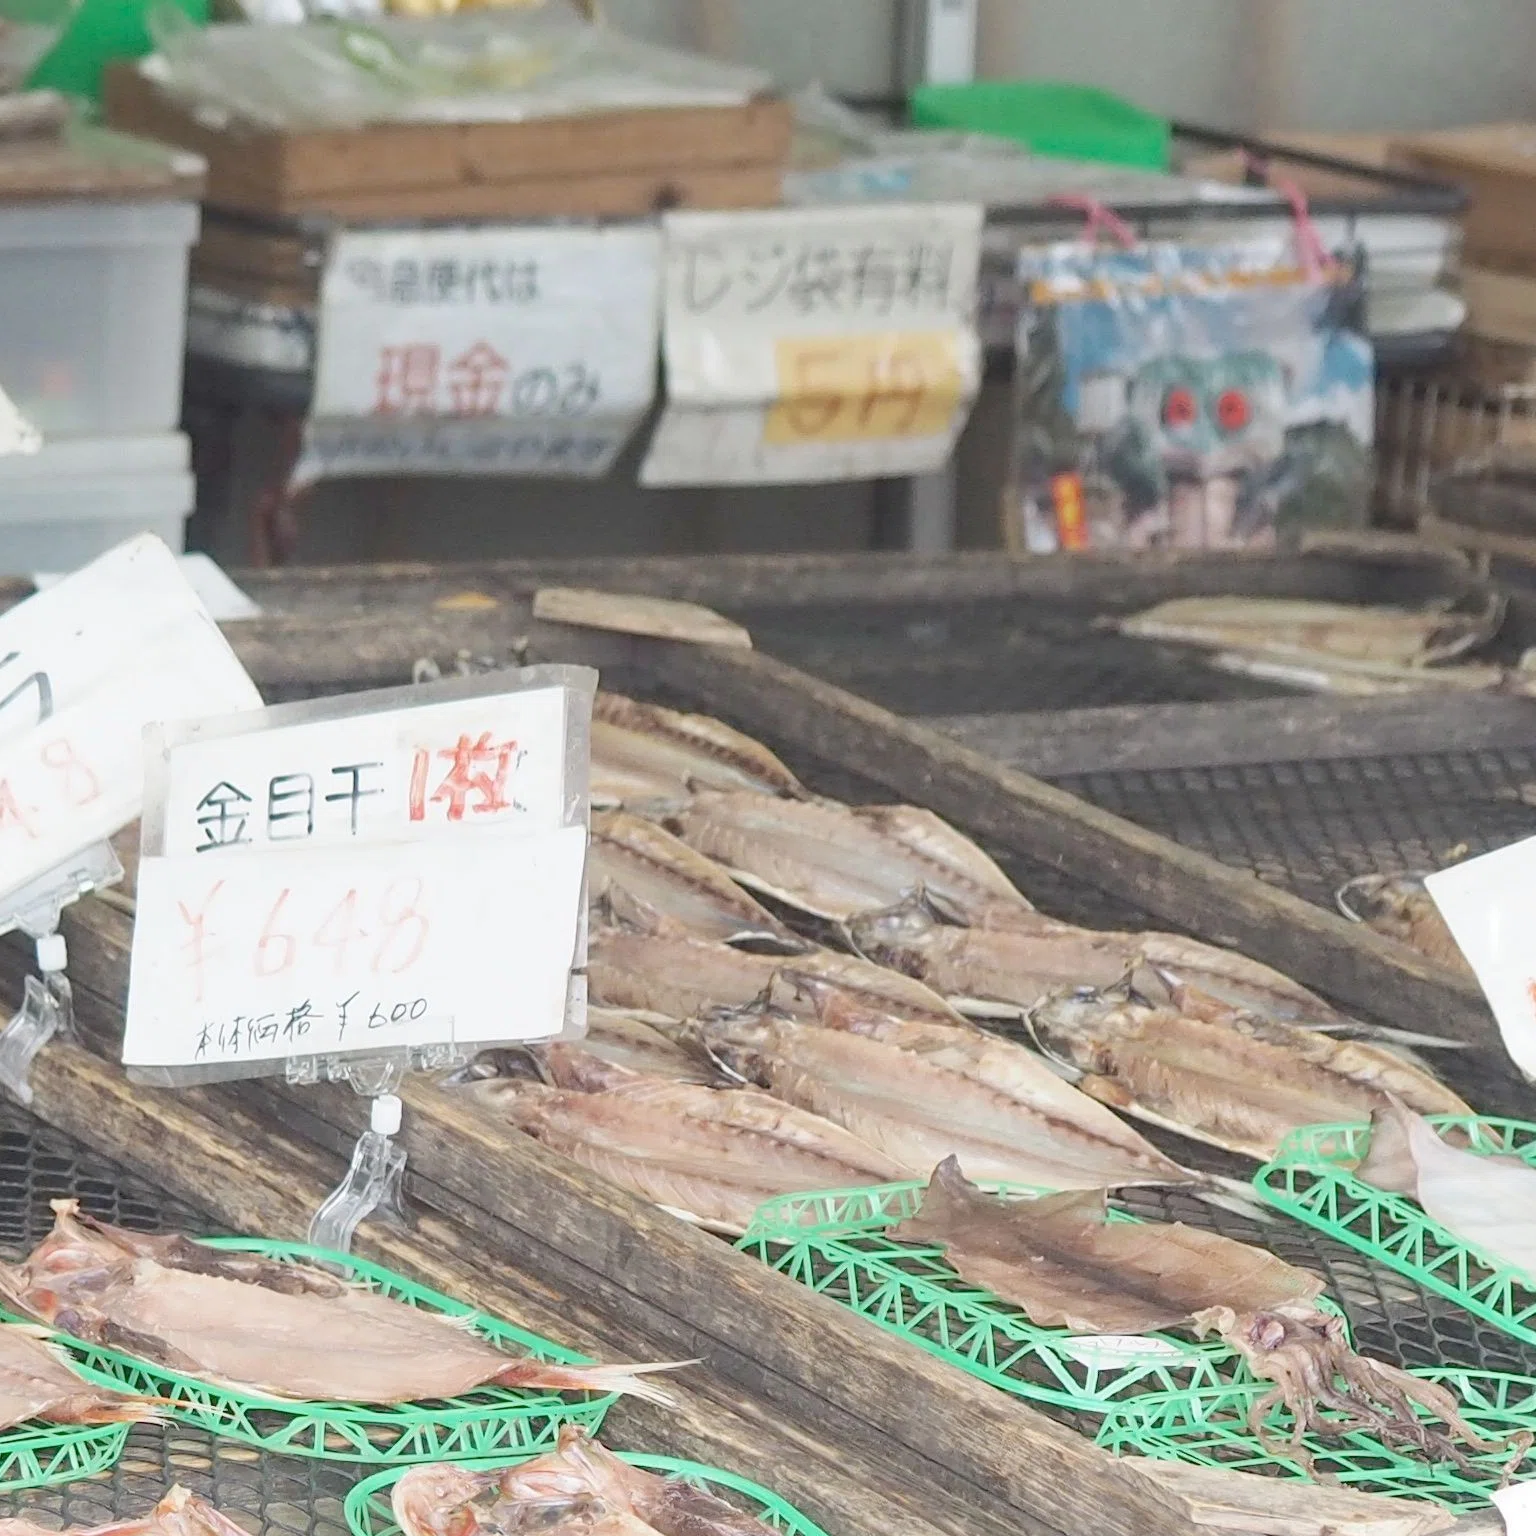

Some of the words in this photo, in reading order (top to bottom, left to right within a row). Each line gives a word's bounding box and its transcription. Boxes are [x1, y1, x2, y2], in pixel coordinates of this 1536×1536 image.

[372, 340, 600, 419] 現金のみ
[175, 876, 433, 1004] ¥648
